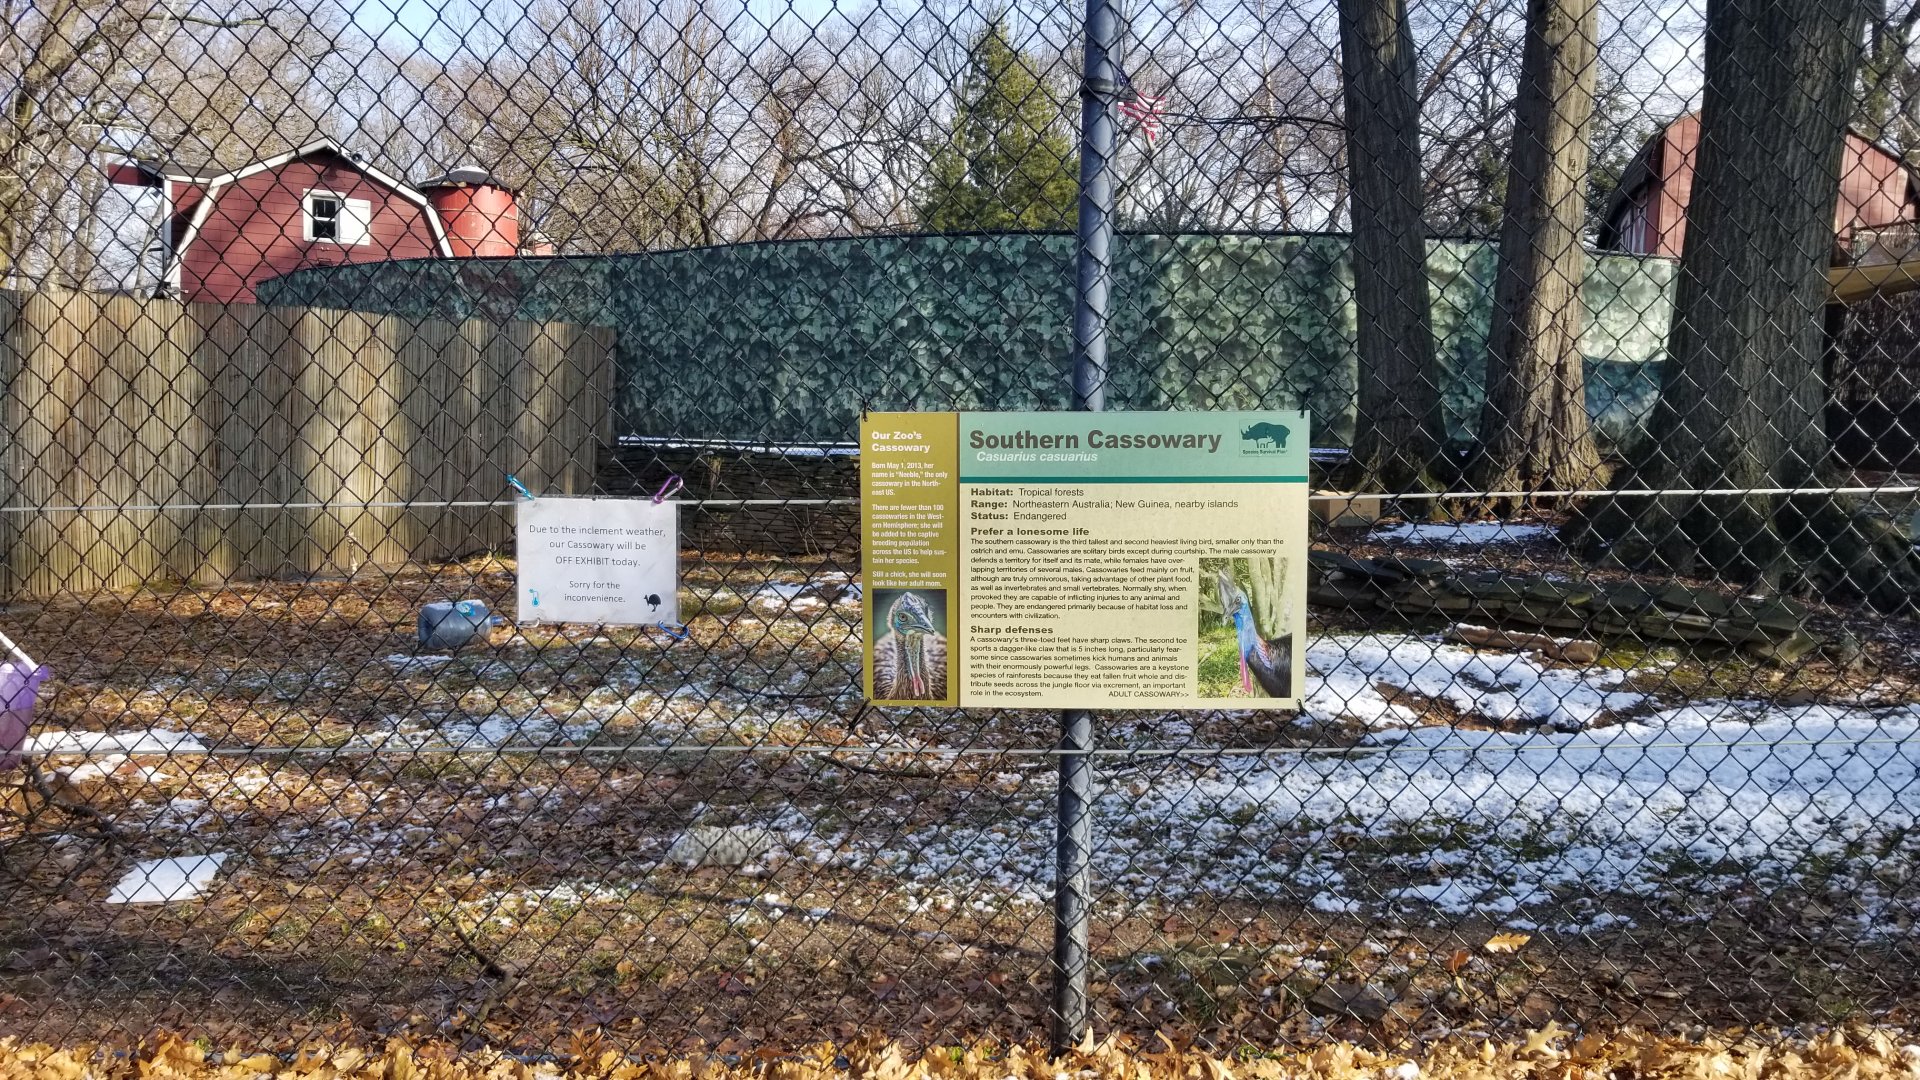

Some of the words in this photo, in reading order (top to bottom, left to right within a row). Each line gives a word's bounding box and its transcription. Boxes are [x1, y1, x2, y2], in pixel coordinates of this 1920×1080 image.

[871, 431, 890, 440] Our
[893, 431, 922, 440] Zoo's
[969, 430, 1079, 449] Southern
[1088, 430, 1222, 453] Cassowary
[871, 443, 930, 453] Cassowary
[976, 451, 1036, 462] Casuarius
[1040, 451, 1098, 462] casuarius
[886, 462, 900, 470] May
[970, 488, 1013, 496] Habitat:
[1019, 488, 1052, 498] Tropical
[1055, 488, 1084, 496] forests
[970, 500, 1007, 510] Range:
[1012, 500, 1069, 508] Northeastern
[1072, 500, 1112, 509] Australia;
[1116, 500, 1135, 508] New
[1138, 500, 1172, 509] Guinea,
[1175, 500, 1205, 510] nearby
[1208, 500, 1239, 508] islands
[970, 512, 1008, 520] Status:
[1014, 512, 1067, 522] Endangered
[529, 525, 547, 533] Due
[550, 526, 559, 534] to
[561, 525, 576, 534] the
[578, 526, 623, 535] inclement
[626, 527, 666, 538] weather,
[970, 527, 1004, 535] Prefer
[568, 540, 614, 550] Cassowary
[616, 541, 632, 550] will
[635, 542, 647, 550] be
[1180, 538, 1198, 546] living
[1241, 538, 1255, 546] only
[1083, 548, 1107, 556] solitary
[1126, 548, 1150, 556] except
[1151, 548, 1172, 556] during
[1174, 548, 1207, 556] courtship.
[555, 556, 572, 564] OFF
[576, 556, 610, 566] EXHIBIT
[612, 558, 640, 568] today.
[1004, 557, 1030, 565] territory
[970, 566, 995, 574] lapping
[569, 581, 590, 590] Sorry
[593, 581, 605, 589] for
[606, 581, 620, 589] the
[564, 594, 626, 602] inconvenience.
[996, 603, 1013, 611] They
[970, 626, 1002, 635] Sharp
[1005, 626, 1054, 634] defenses
